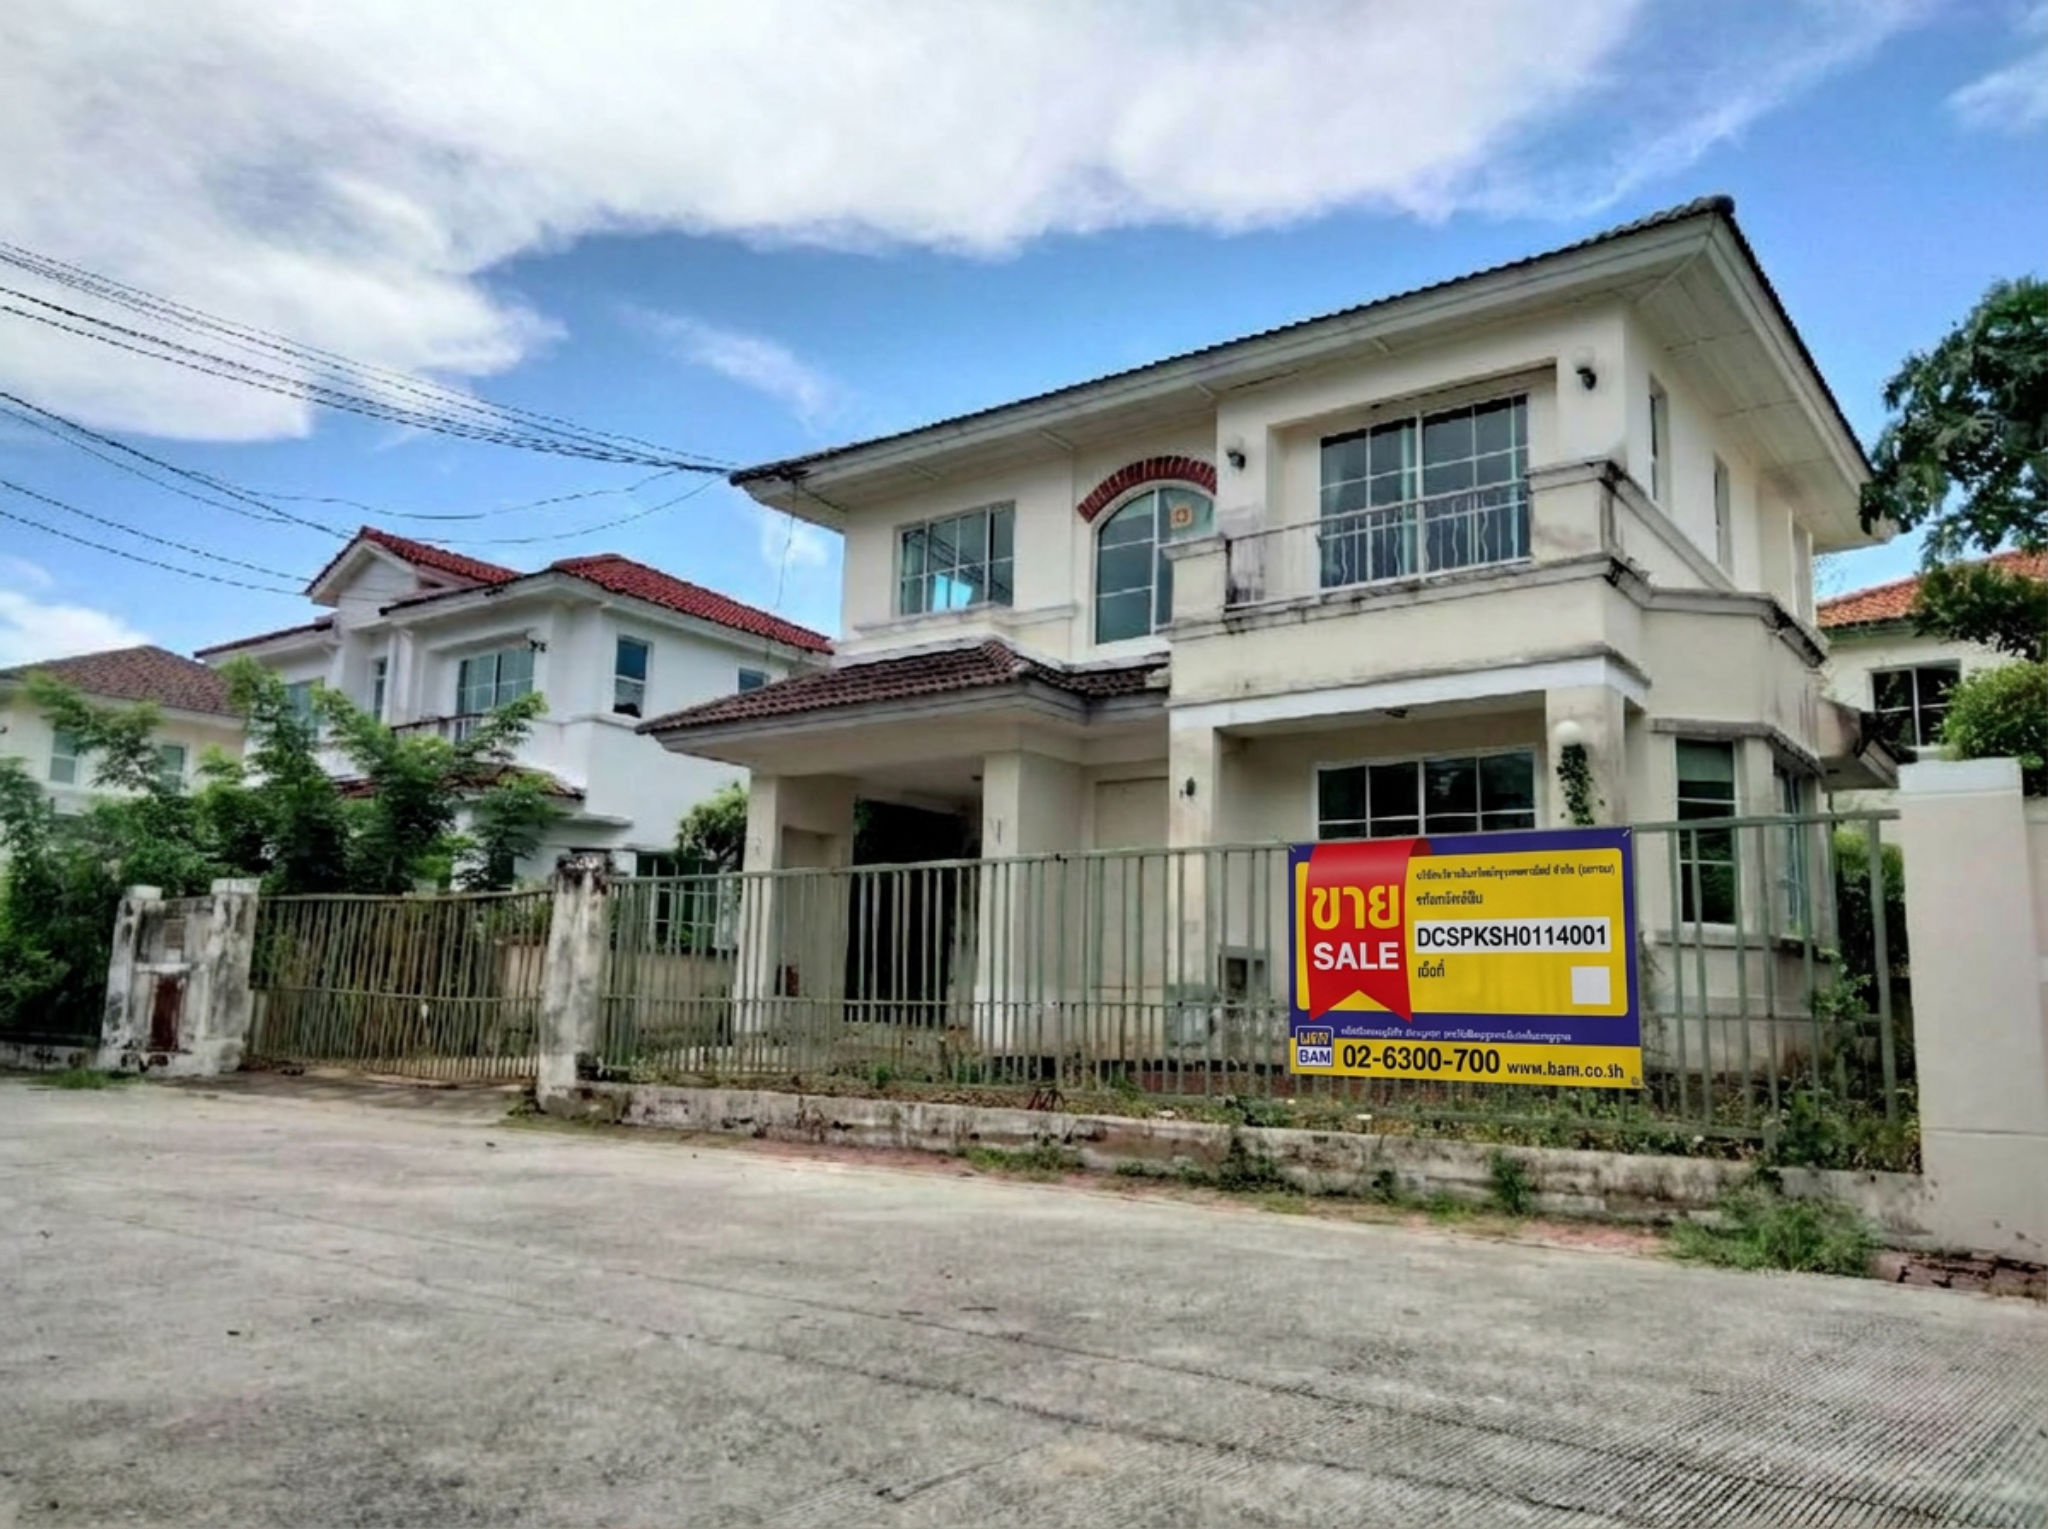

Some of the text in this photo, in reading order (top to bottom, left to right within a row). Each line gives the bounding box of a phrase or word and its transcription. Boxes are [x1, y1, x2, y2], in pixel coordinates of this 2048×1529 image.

[1311, 884, 1399, 930] ขาย
[1417, 925, 1606, 947] DCSPKSH0114001
[1313, 942, 1399, 971] SALE
[1299, 1050, 1331, 1063] BAM
[1343, 1045, 1500, 1074] 02-6300-700
